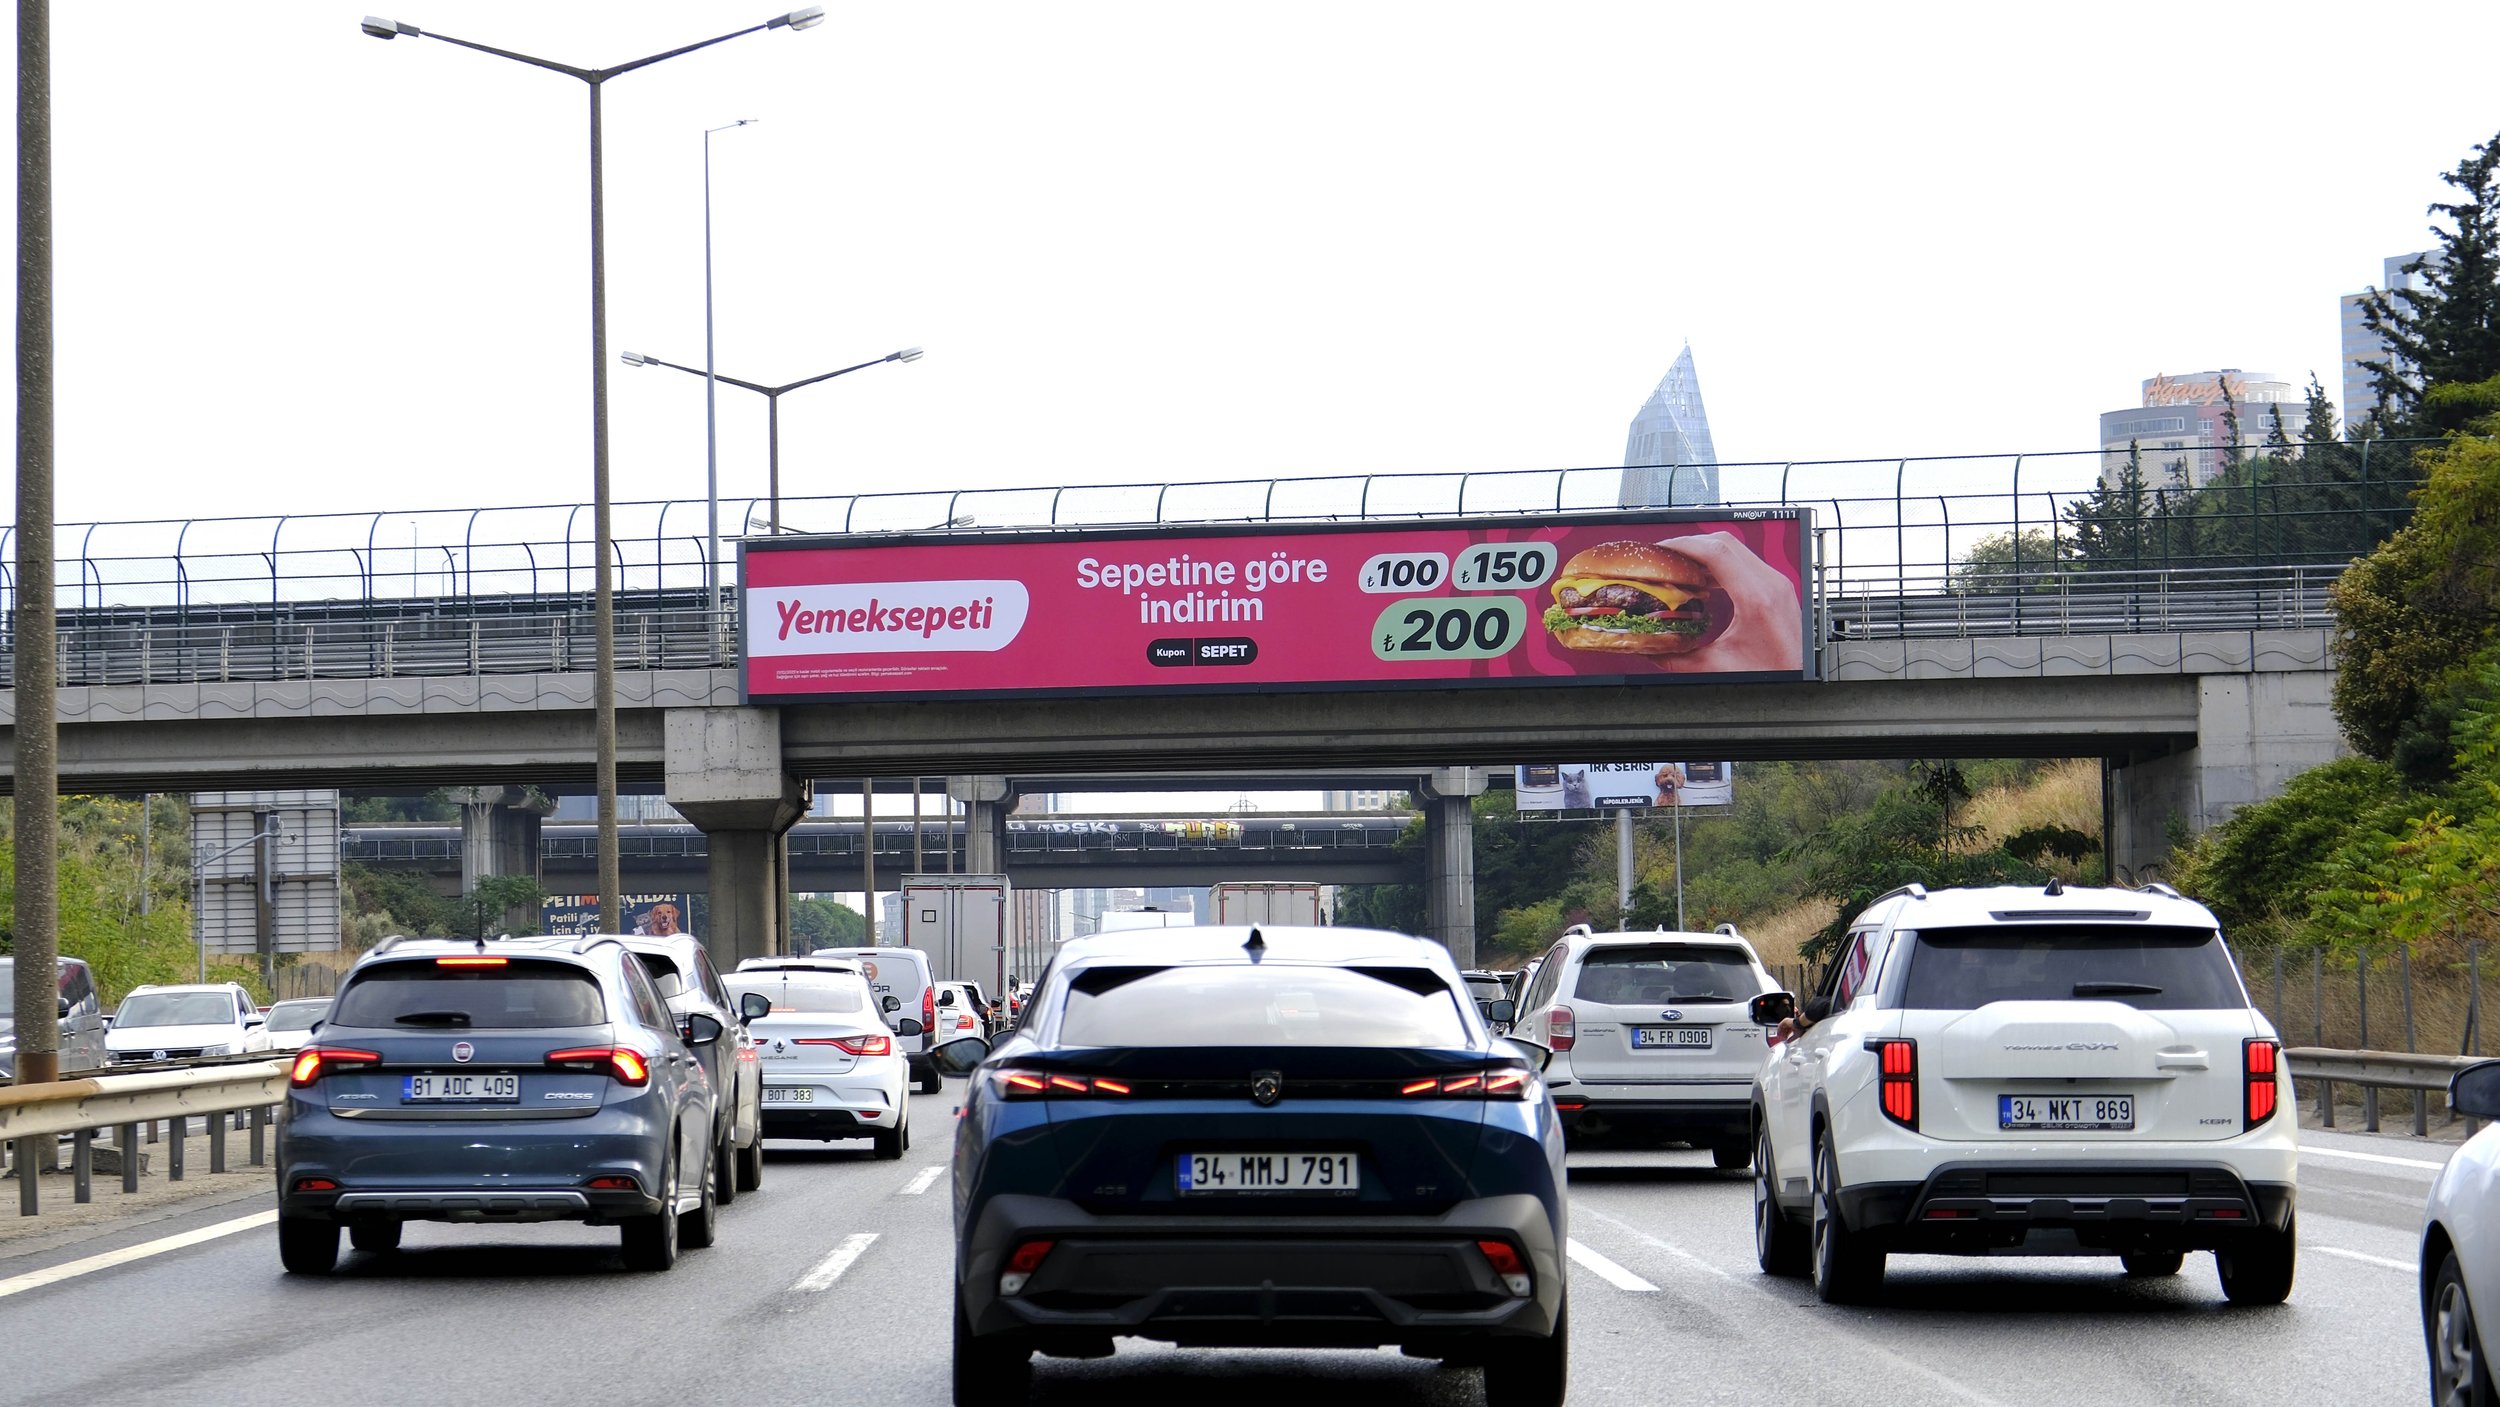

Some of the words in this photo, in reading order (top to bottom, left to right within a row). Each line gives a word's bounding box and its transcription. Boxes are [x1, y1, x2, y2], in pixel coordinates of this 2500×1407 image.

[1772, 510, 1796, 519] 1111
[1077, 554, 1236, 595] Sepetine
[1245, 552, 1328, 592] göre
[1140, 590, 1264, 624] indirim
[776, 597, 994, 641] Yemeksepeti
[1156, 648, 1186, 658] Kupon
[1201, 645, 1248, 658] SEPET
[549, 913, 578, 923] Patili
[1641, 1031, 1654, 1043] 34
[1660, 1031, 1674, 1043] FR
[1679, 1031, 1708, 1043] 0908
[414, 1078, 431, 1095] 81
[443, 1078, 472, 1095] ADC
[483, 1078, 515, 1095] 409
[544, 1092, 595, 1100] CROSS
[768, 1090, 786, 1101] BOT
[793, 1090, 811, 1101] 383
[2014, 1101, 2036, 1120] 34
[2049, 1100, 2082, 1120] NKT
[2096, 1101, 2130, 1120] 869
[1194, 1157, 1225, 1186] 34
[1240, 1157, 1289, 1186] MMJ
[1301, 1157, 1350, 1186] 791
